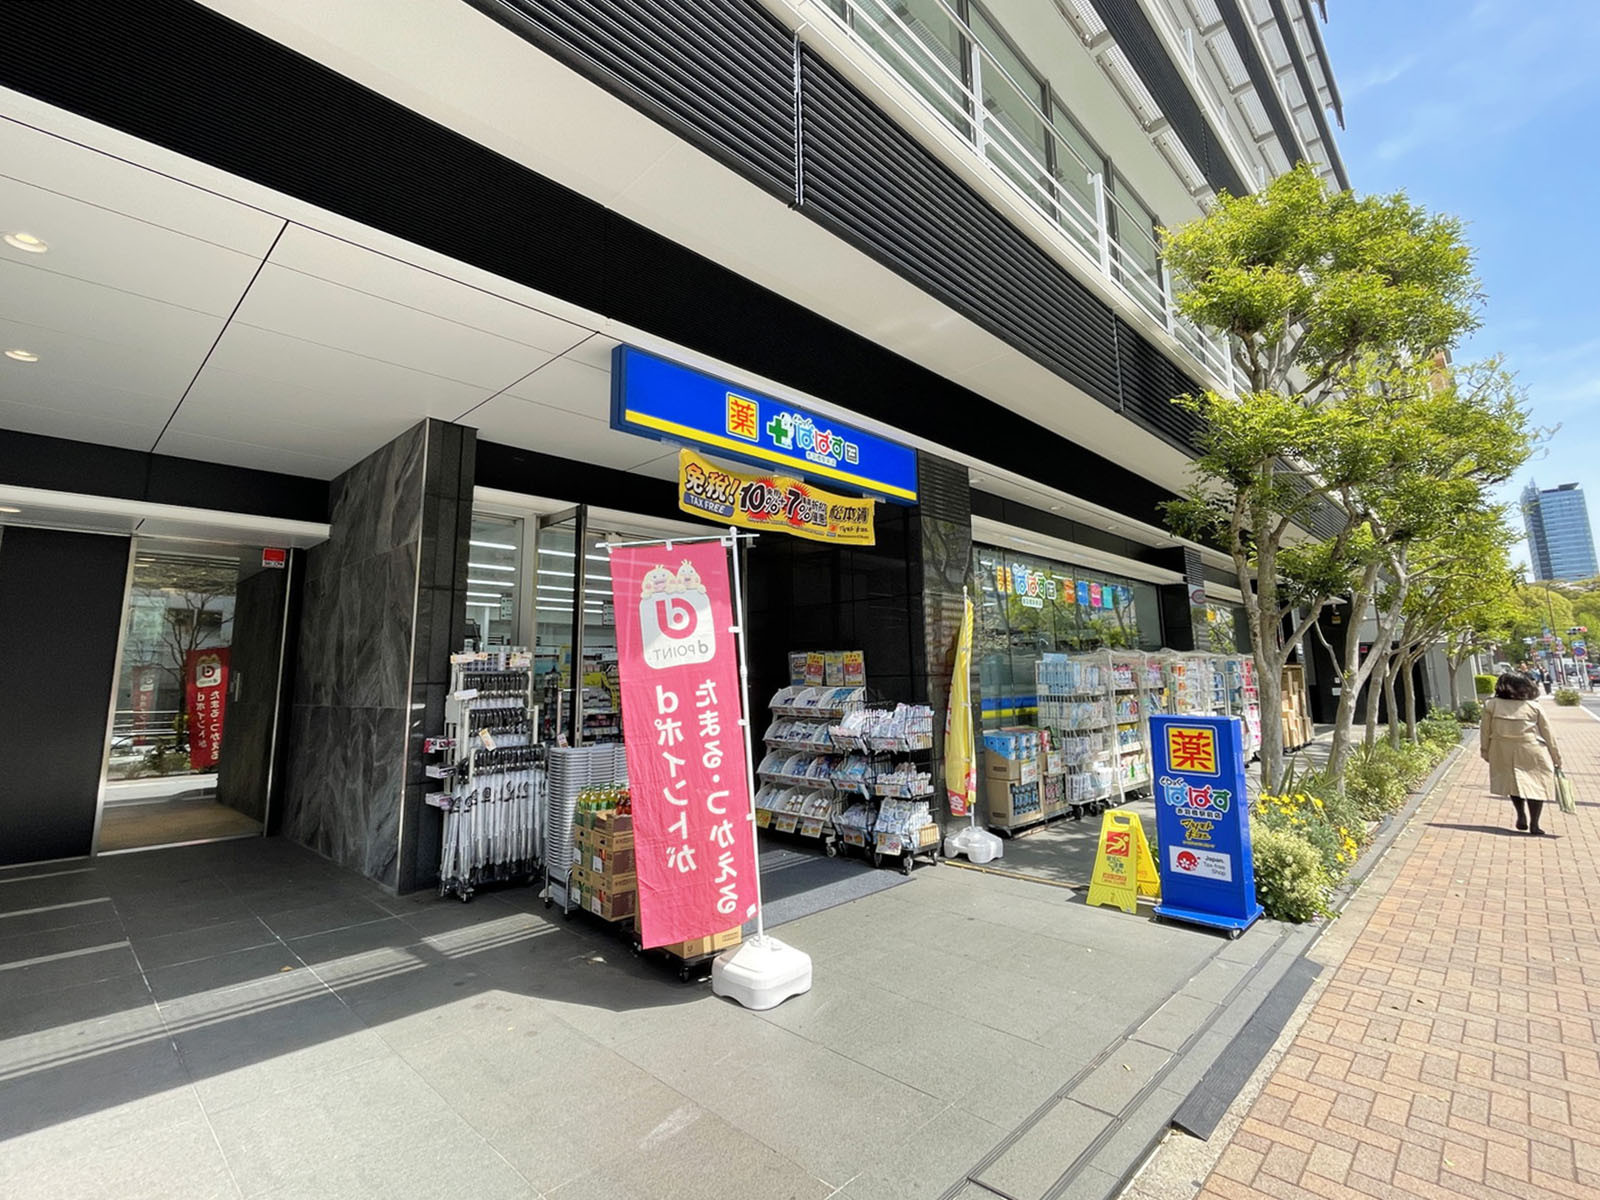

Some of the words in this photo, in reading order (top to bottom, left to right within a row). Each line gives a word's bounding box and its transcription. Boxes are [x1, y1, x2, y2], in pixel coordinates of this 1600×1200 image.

[730, 399, 755, 437] 薬
[689, 495, 704, 508] TAX
[704, 500, 726, 514] FREE
[1171, 731, 1213, 770] 薬
[1165, 784, 1230, 812] ぱぱす
